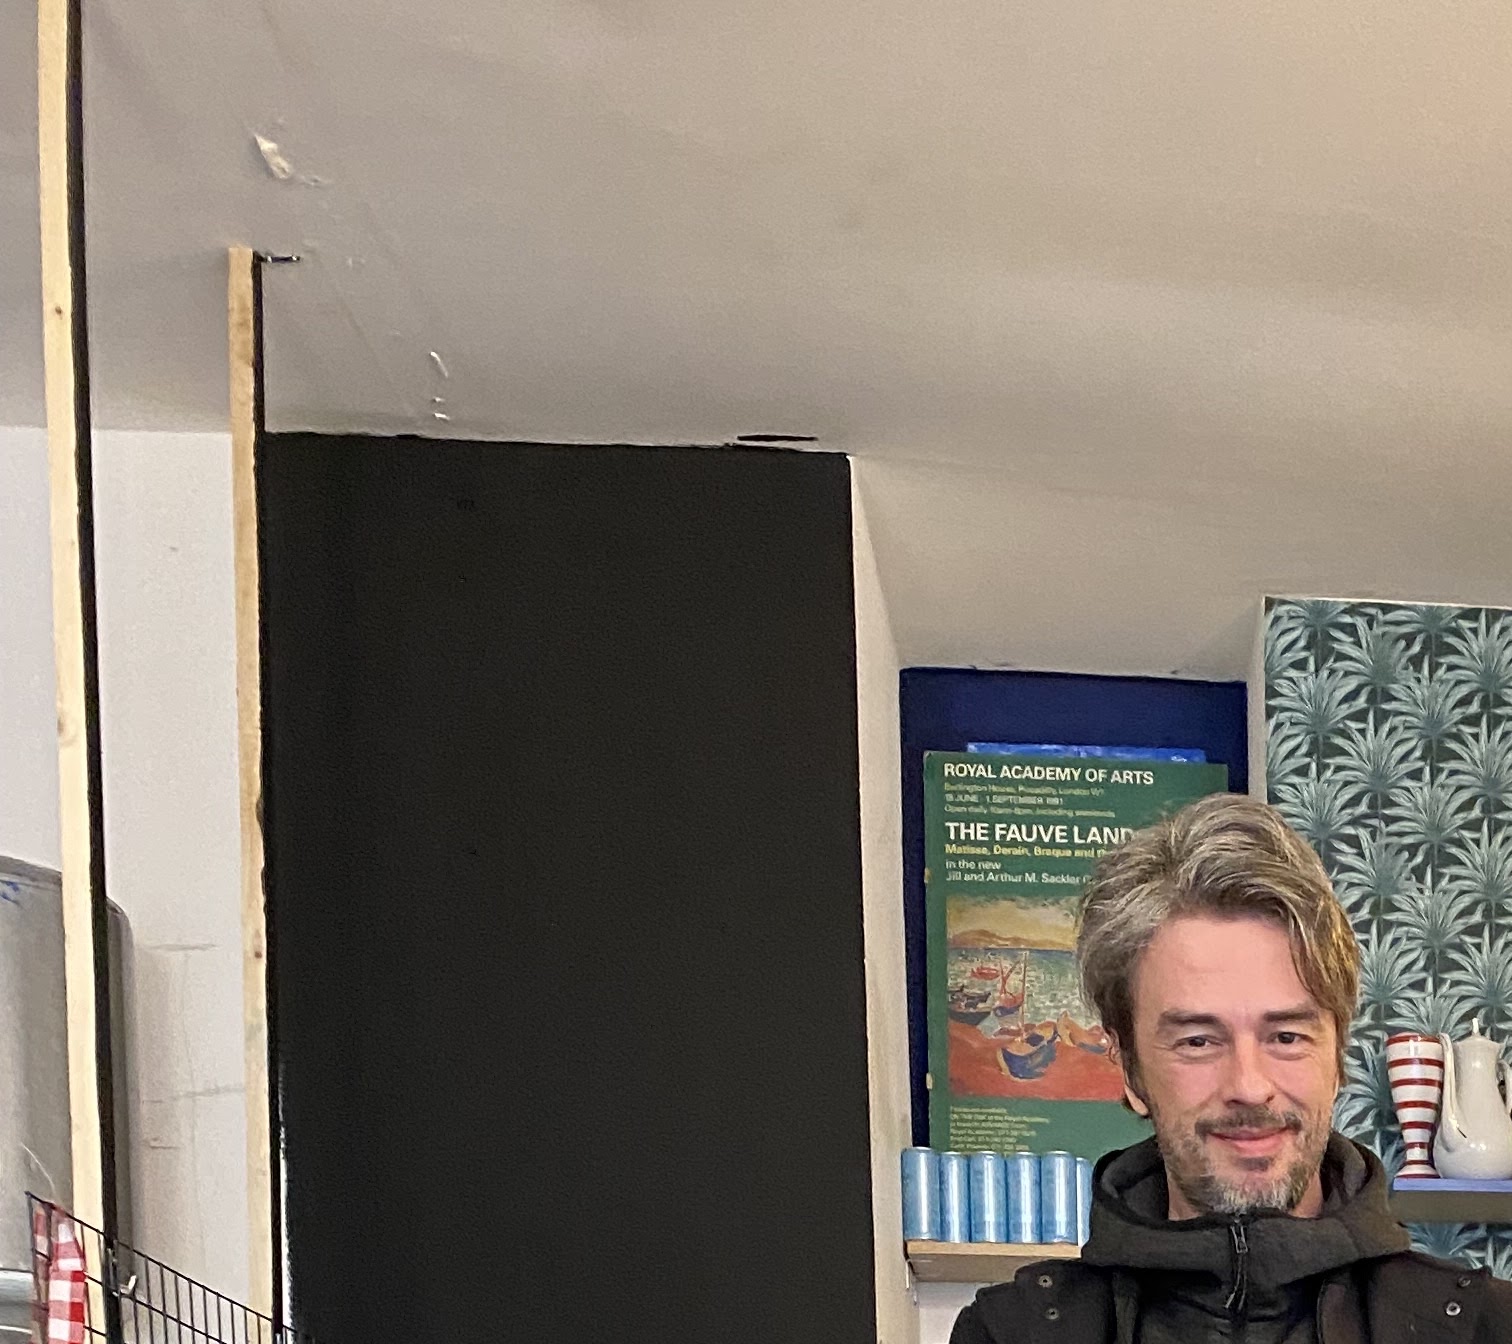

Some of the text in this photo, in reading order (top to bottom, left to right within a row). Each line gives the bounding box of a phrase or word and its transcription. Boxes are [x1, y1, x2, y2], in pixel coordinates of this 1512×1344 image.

[944, 763, 1154, 785] ROYAL ACADEMY OF ARTS
[945, 822, 989, 841] THE
[995, 823, 1069, 844] FAUVE
[945, 844, 991, 855] Matisse,
[993, 844, 1031, 857] Derain,
[1034, 845, 1073, 858] Braque
[1074, 847, 1095, 858] and
[945, 859, 1001, 870] in the new
[946, 870, 962, 881] Jill
[964, 871, 985, 882] and
[986, 871, 1024, 883] Arthur
[1024, 872, 1039, 883] M.
[1041, 873, 1081, 885] Sackler
